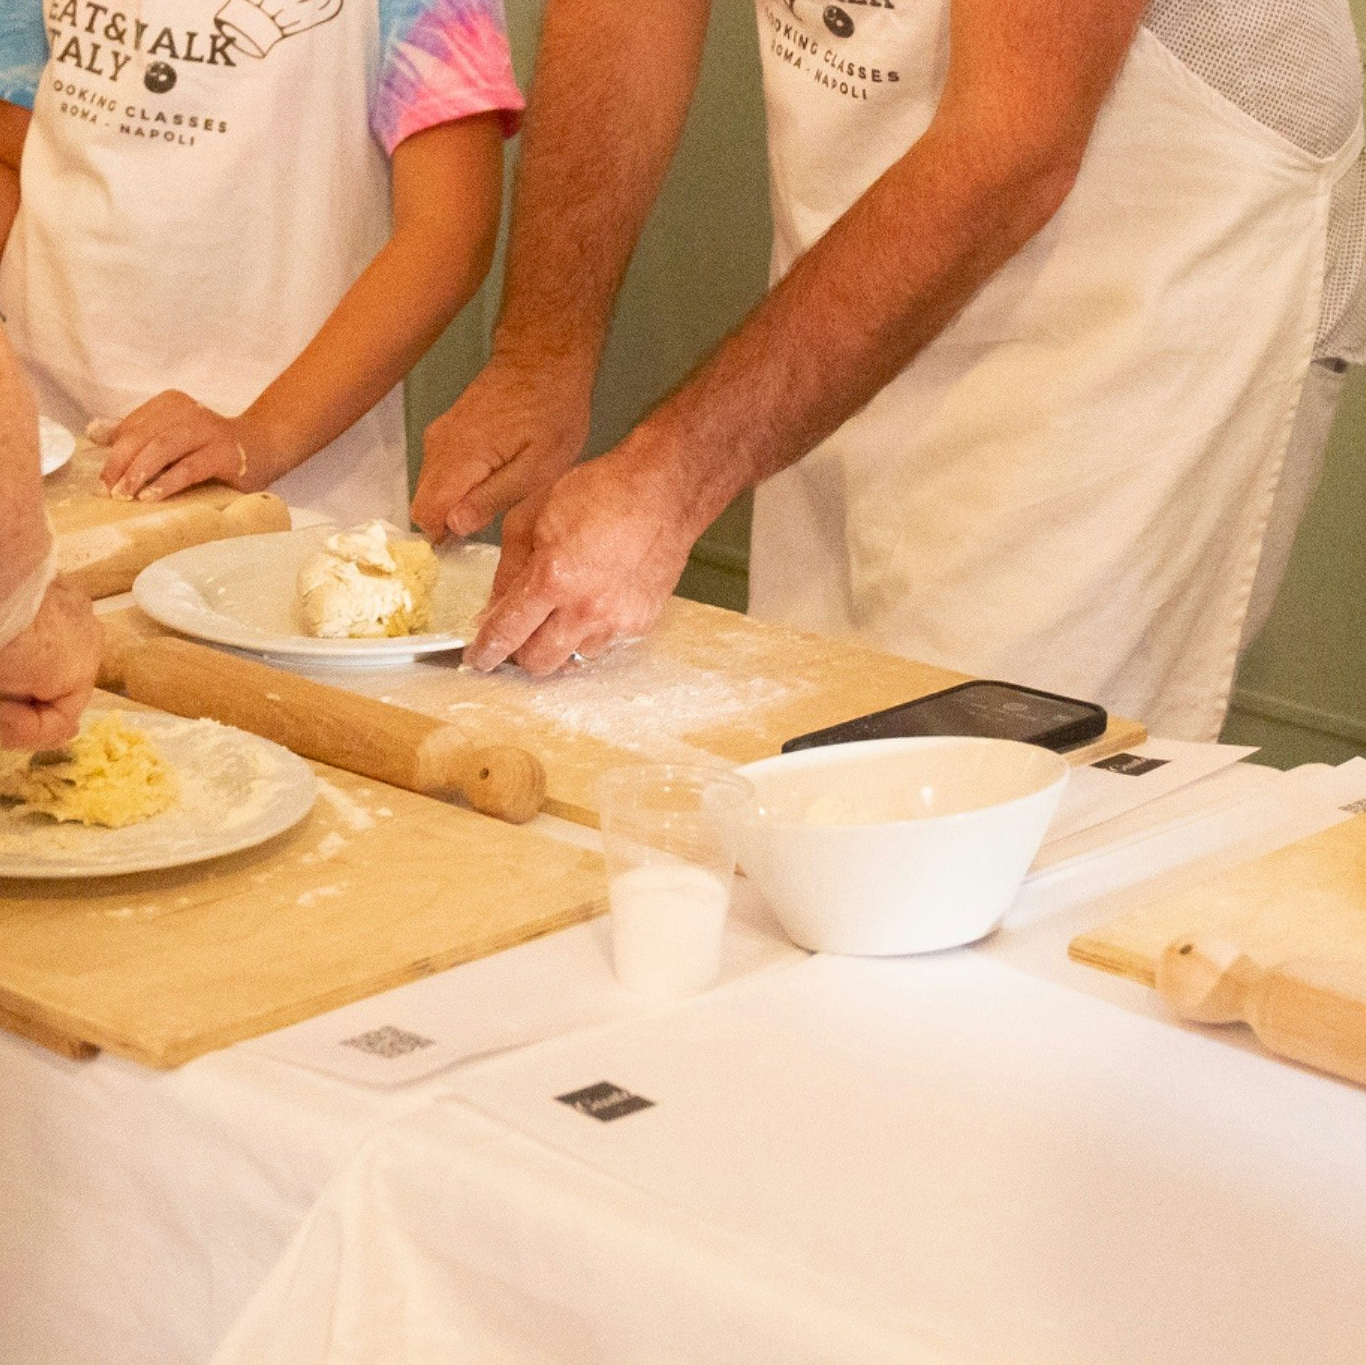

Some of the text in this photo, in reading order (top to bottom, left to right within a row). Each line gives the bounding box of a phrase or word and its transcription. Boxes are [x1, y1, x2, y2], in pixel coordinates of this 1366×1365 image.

[824, 49, 901, 83] CLASSES
[60, 102, 98, 124] ROMA
[119, 122, 195, 147] NAPOLI
[125, 105, 228, 134] CLASSES
